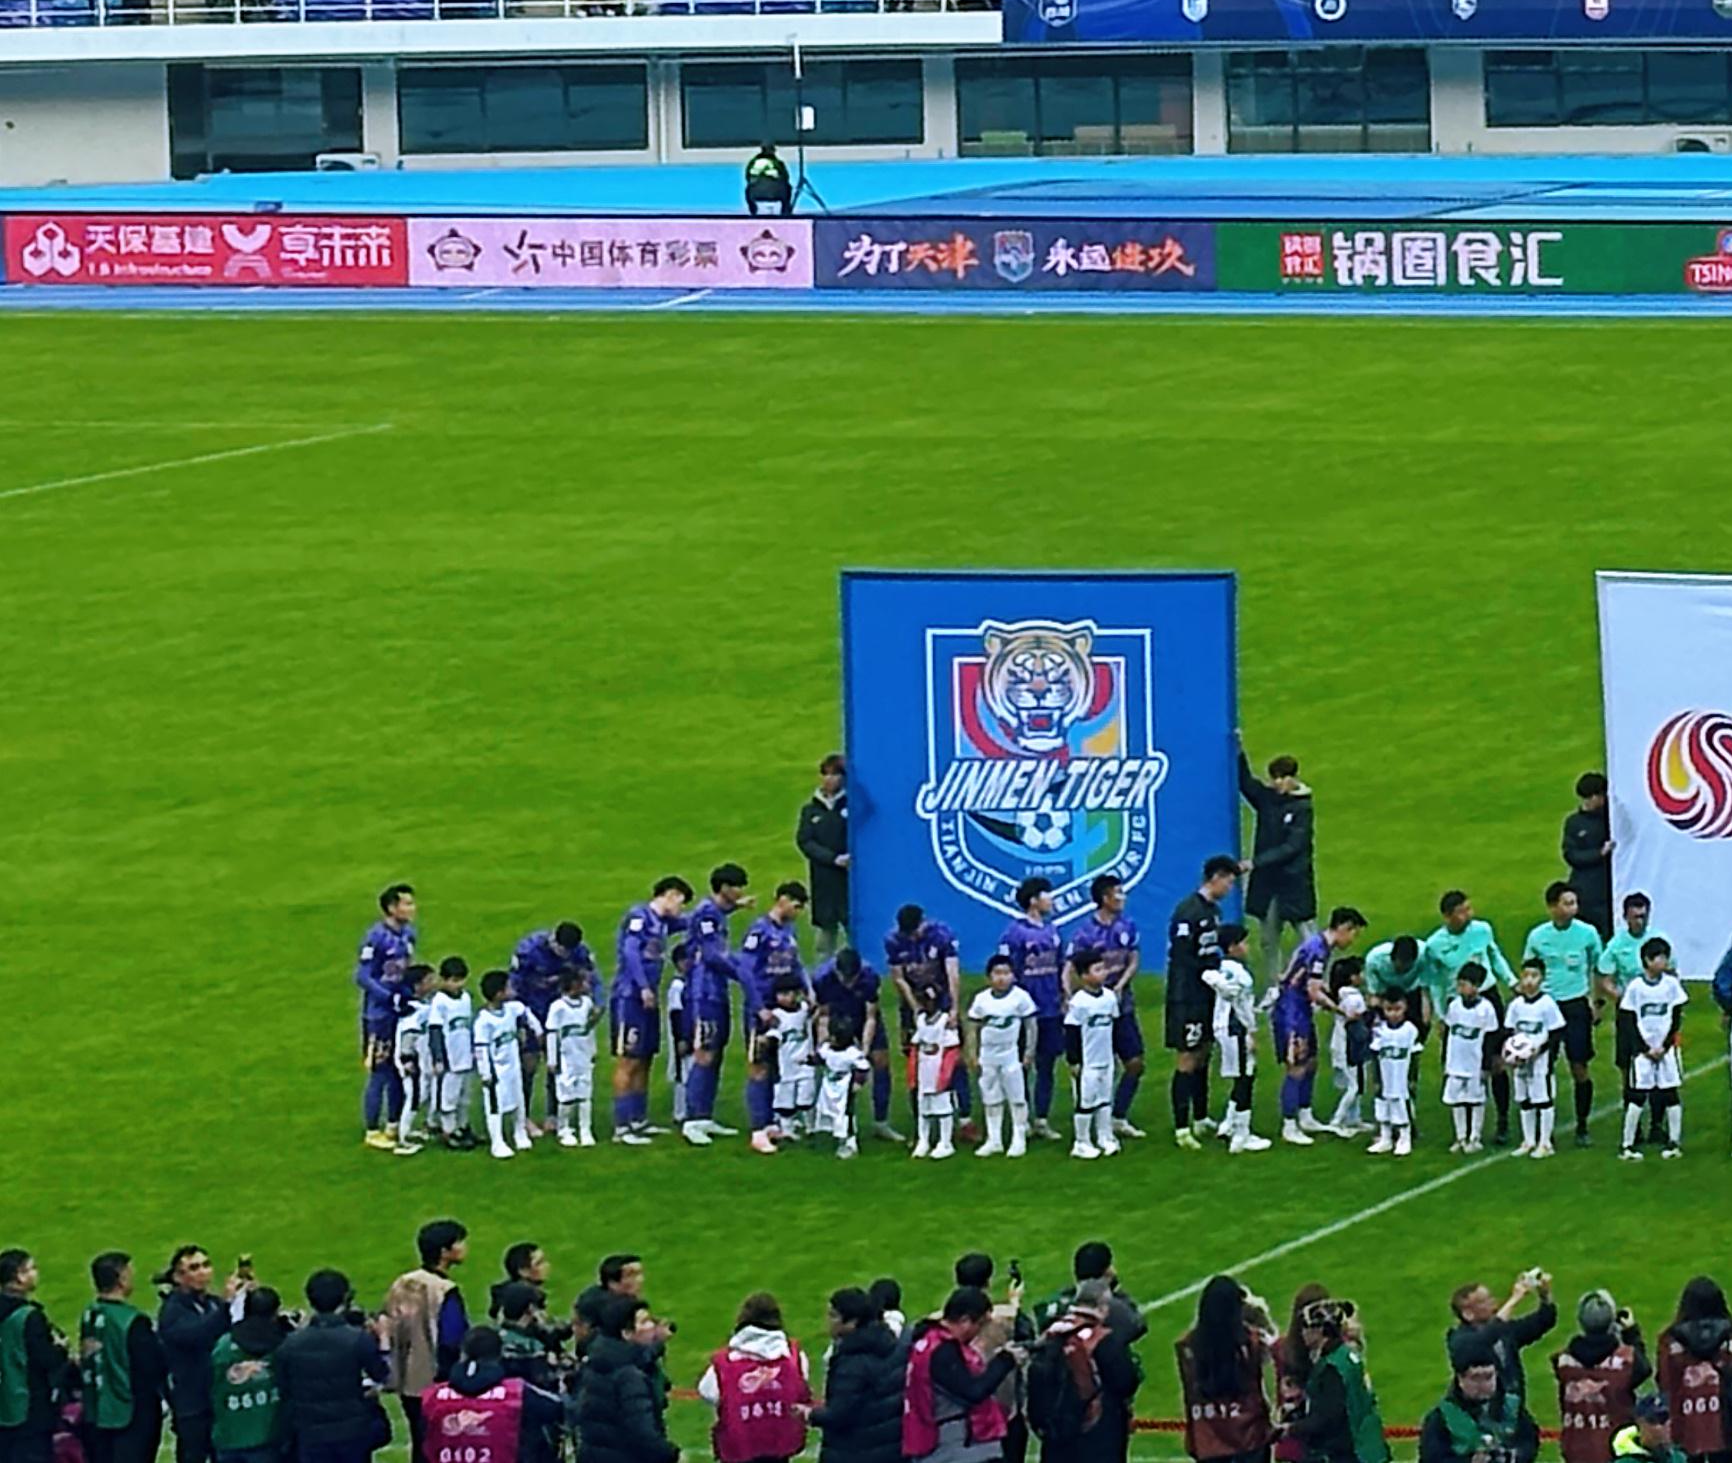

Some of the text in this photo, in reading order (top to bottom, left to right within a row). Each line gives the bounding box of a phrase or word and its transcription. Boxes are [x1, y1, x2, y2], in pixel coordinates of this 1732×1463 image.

[85, 224, 215, 255] 天保基建
[277, 224, 391, 267] 享未来
[551, 239, 719, 269] 中国体育彩票
[1332, 231, 1565, 287] 锅圈食汇
[923, 758, 1161, 811] JINMEN TIGER
